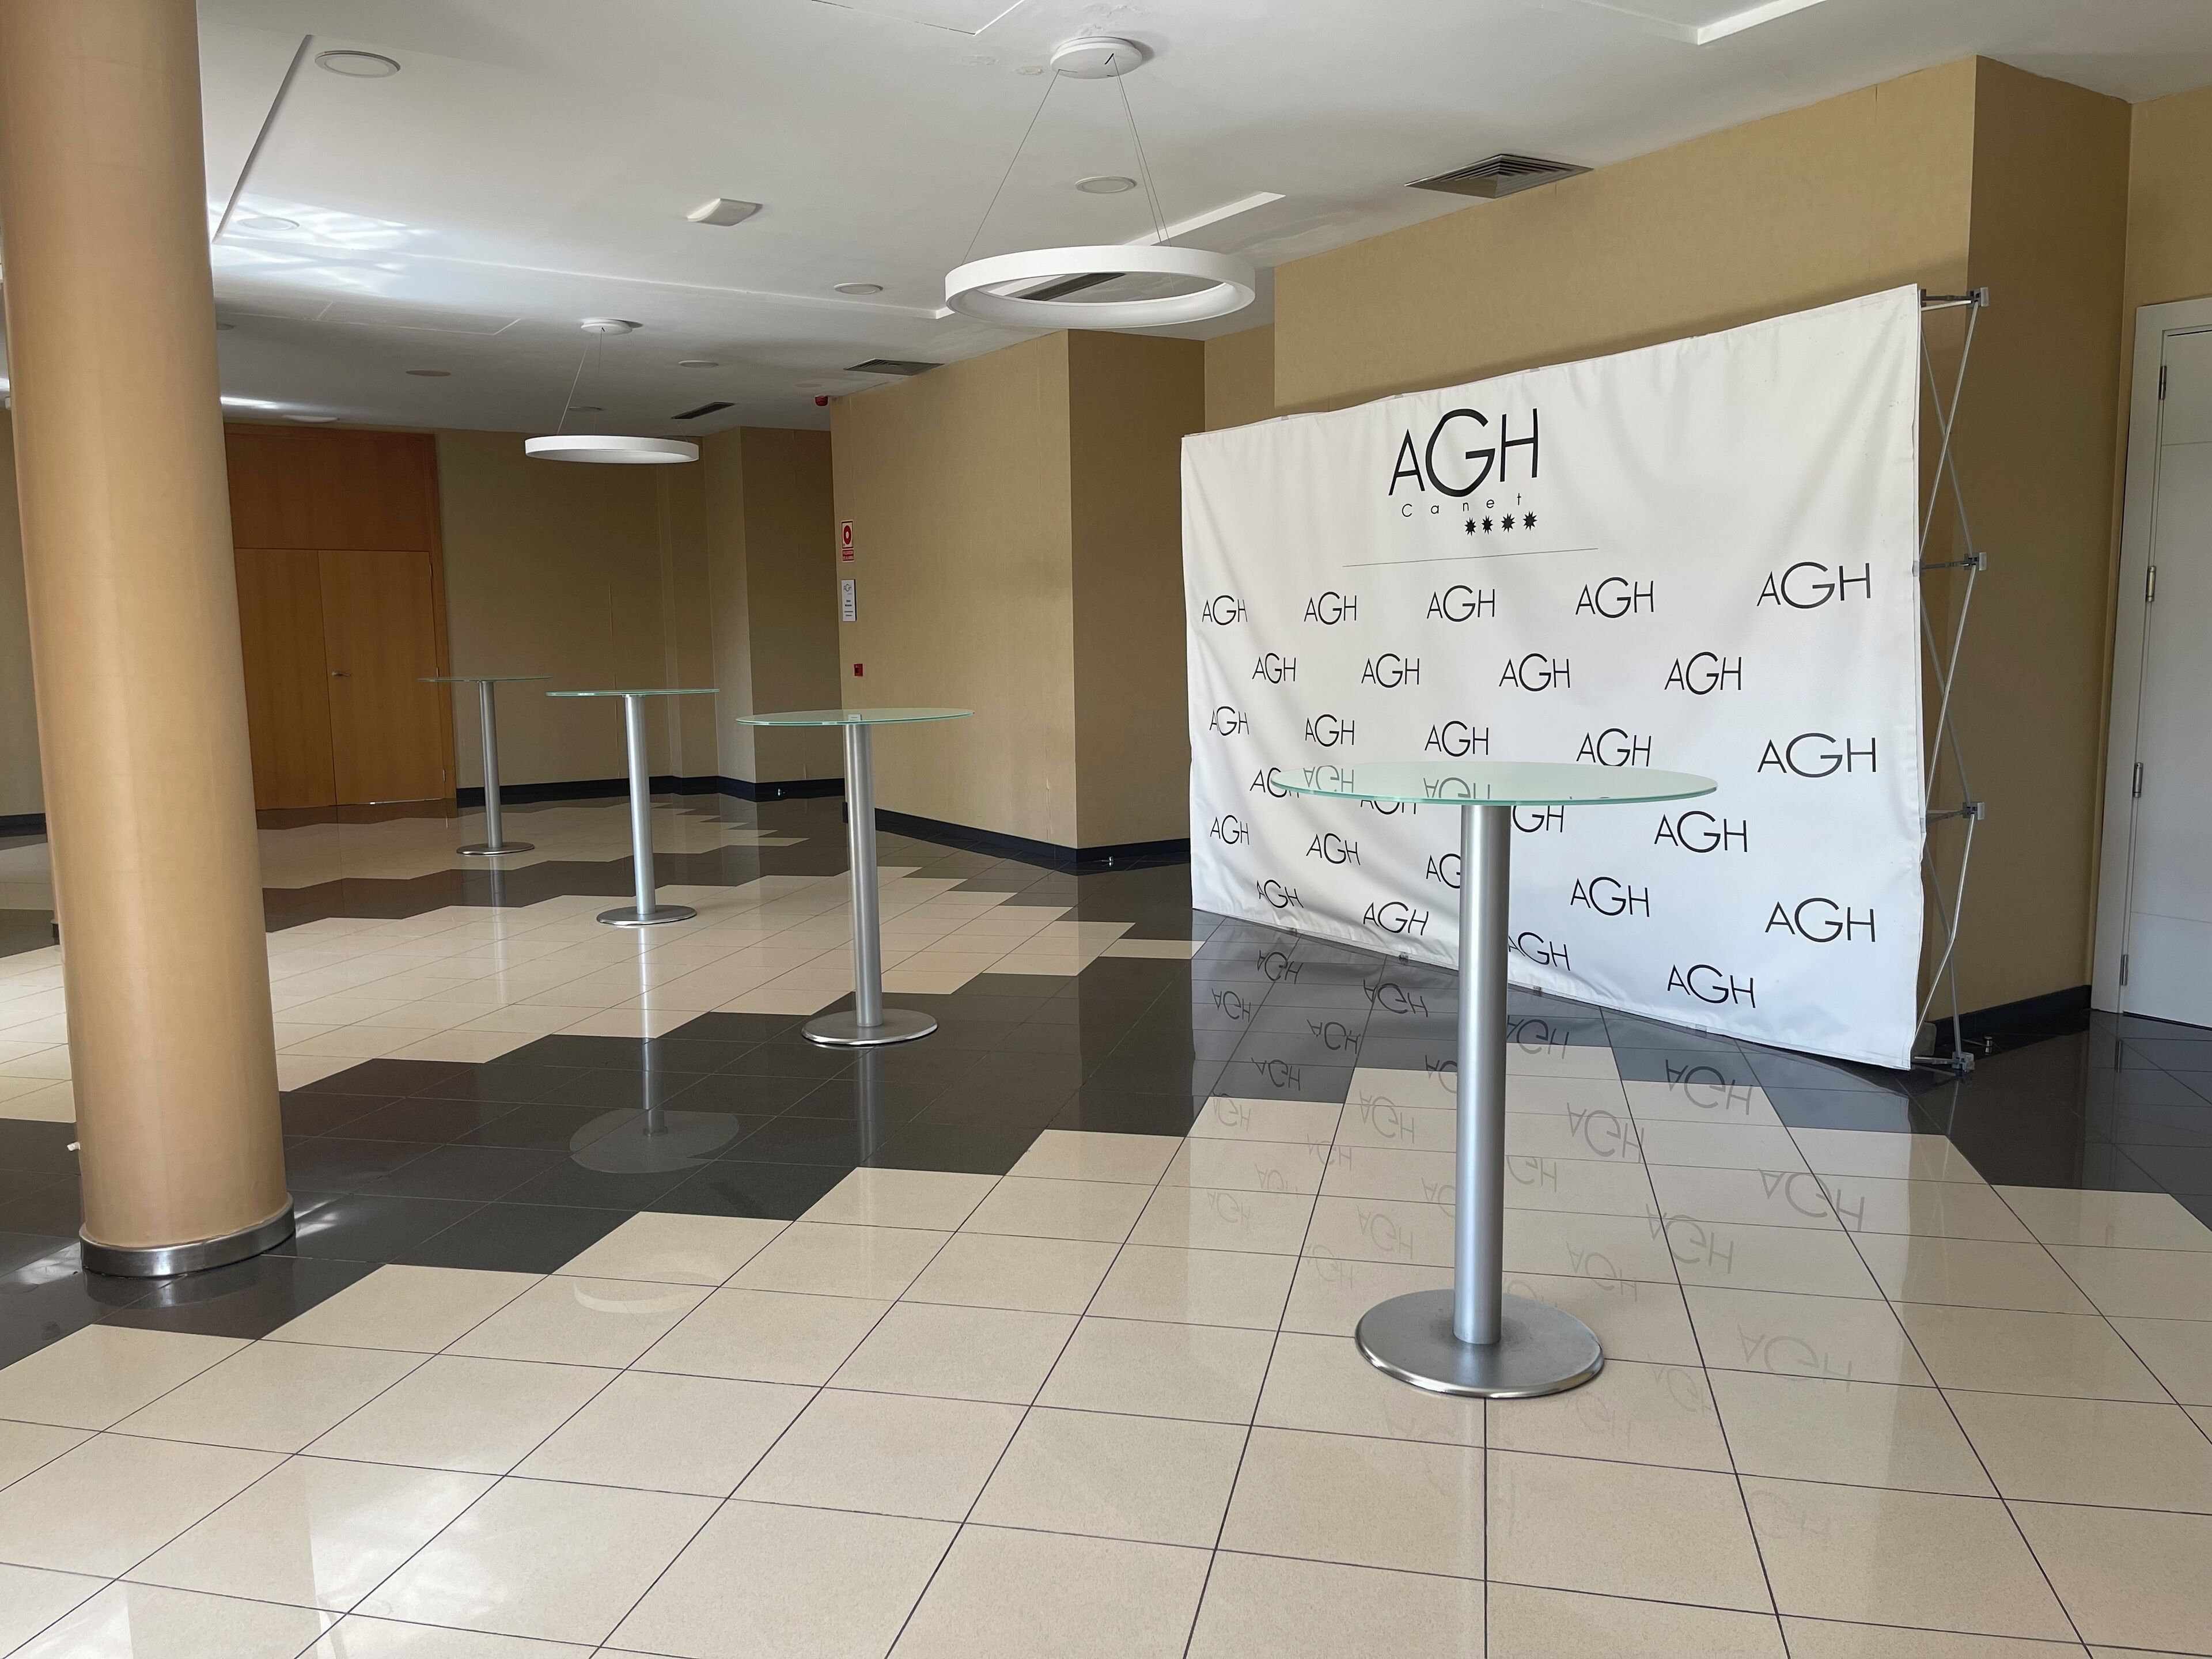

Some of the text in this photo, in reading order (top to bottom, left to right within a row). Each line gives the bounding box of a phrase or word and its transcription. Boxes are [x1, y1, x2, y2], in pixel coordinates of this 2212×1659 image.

[1388, 408, 1538, 497] AGH
[1402, 493, 1522, 517] Canet
[1427, 585, 1495, 622] AGH
[1575, 577, 1654, 618] AGH
[1756, 562, 1871, 609] AGH
[1202, 595, 1248, 626] AGH
[1304, 592, 1357, 625] AGH
[1252, 653, 1296, 684] AGH
[1361, 653, 1419, 688] AGH
[1499, 653, 1570, 692] AGH
[1664, 652, 1741, 695] AGH
[1209, 706, 1249, 736] AGH
[1305, 714, 1355, 747] AGH
[1425, 721, 1488, 757] AGH
[1576, 728, 1652, 767] AGH
[1758, 733, 1876, 778] AGH
[1249, 767, 1300, 798] AG
[1210, 815, 1249, 845] AGH
[1513, 805, 1564, 833] GH
[1654, 810, 1748, 853] AGH
[1306, 833, 1361, 865] AGH
[1426, 853, 1460, 889] AG
[1256, 880, 1304, 908] AGH
[1570, 877, 1649, 917] AGH
[1363, 902, 1429, 935] AGH
[1765, 897, 1875, 942] AGH
[1667, 964, 1756, 1008] AGH
